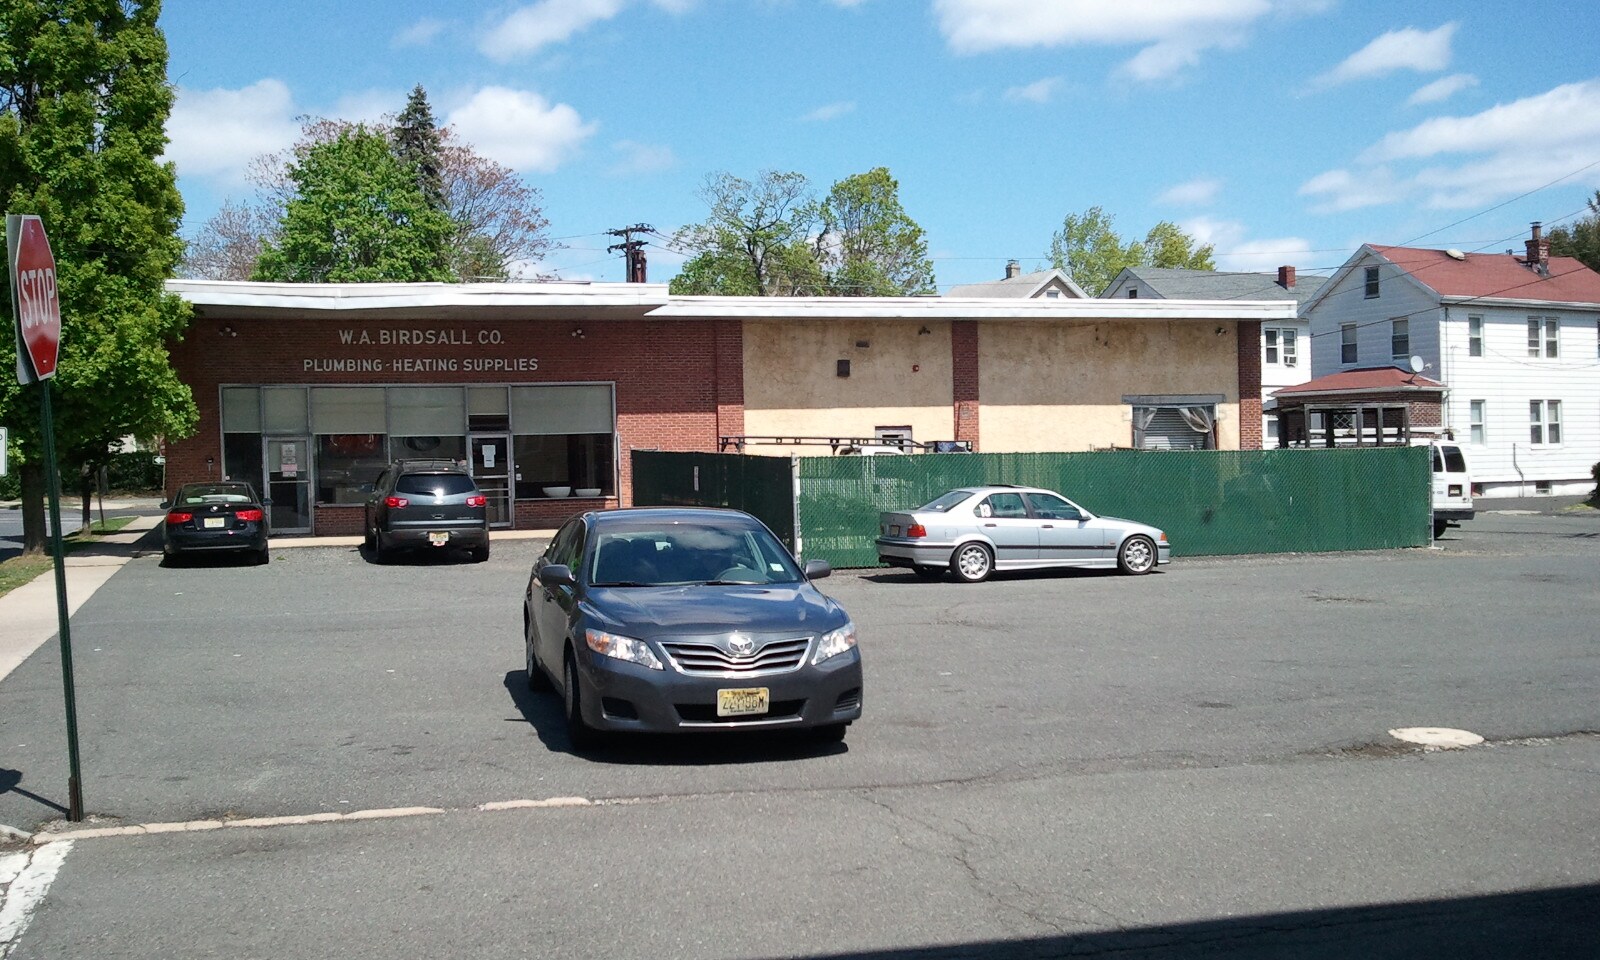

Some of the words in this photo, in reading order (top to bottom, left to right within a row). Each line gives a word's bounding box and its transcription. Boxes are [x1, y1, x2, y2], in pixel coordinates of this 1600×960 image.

[21, 267, 55, 329] STOP
[379, 329, 473, 345] BIRDSALL
[478, 329, 505, 345] CO.
[463, 357, 539, 372] SUPPLIES
